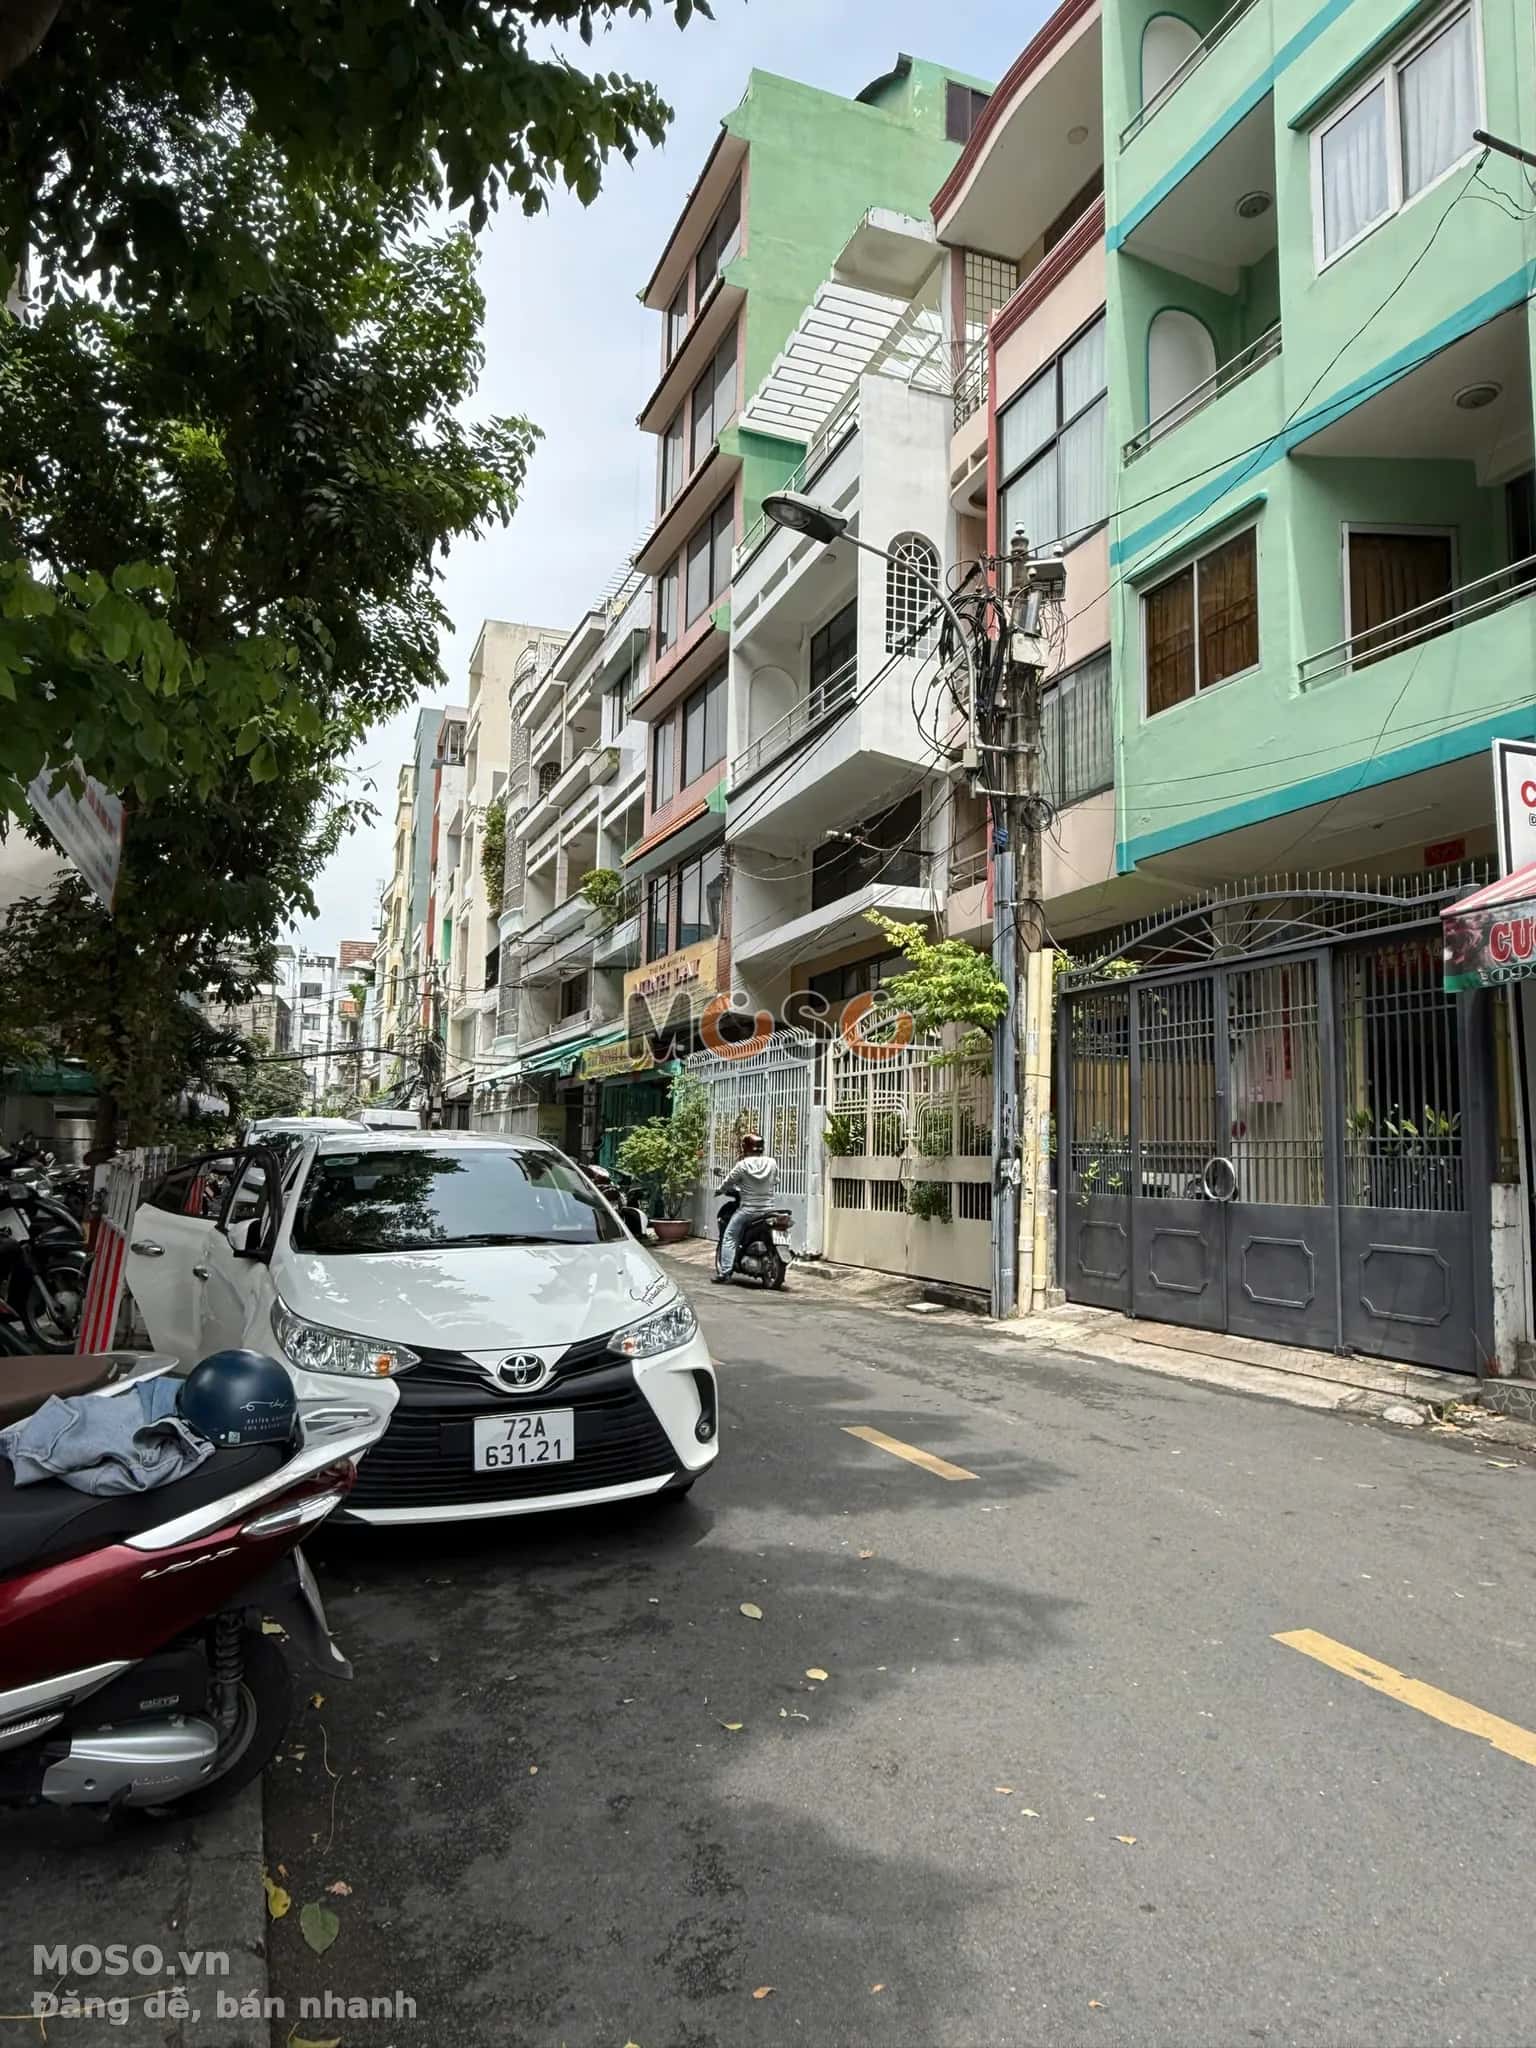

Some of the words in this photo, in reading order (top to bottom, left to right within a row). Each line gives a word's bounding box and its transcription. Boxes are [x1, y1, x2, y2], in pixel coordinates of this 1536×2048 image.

[1489, 916, 1536, 962] CƯ
[503, 1416, 546, 1441] 72A
[485, 1439, 561, 1467] 631.21
